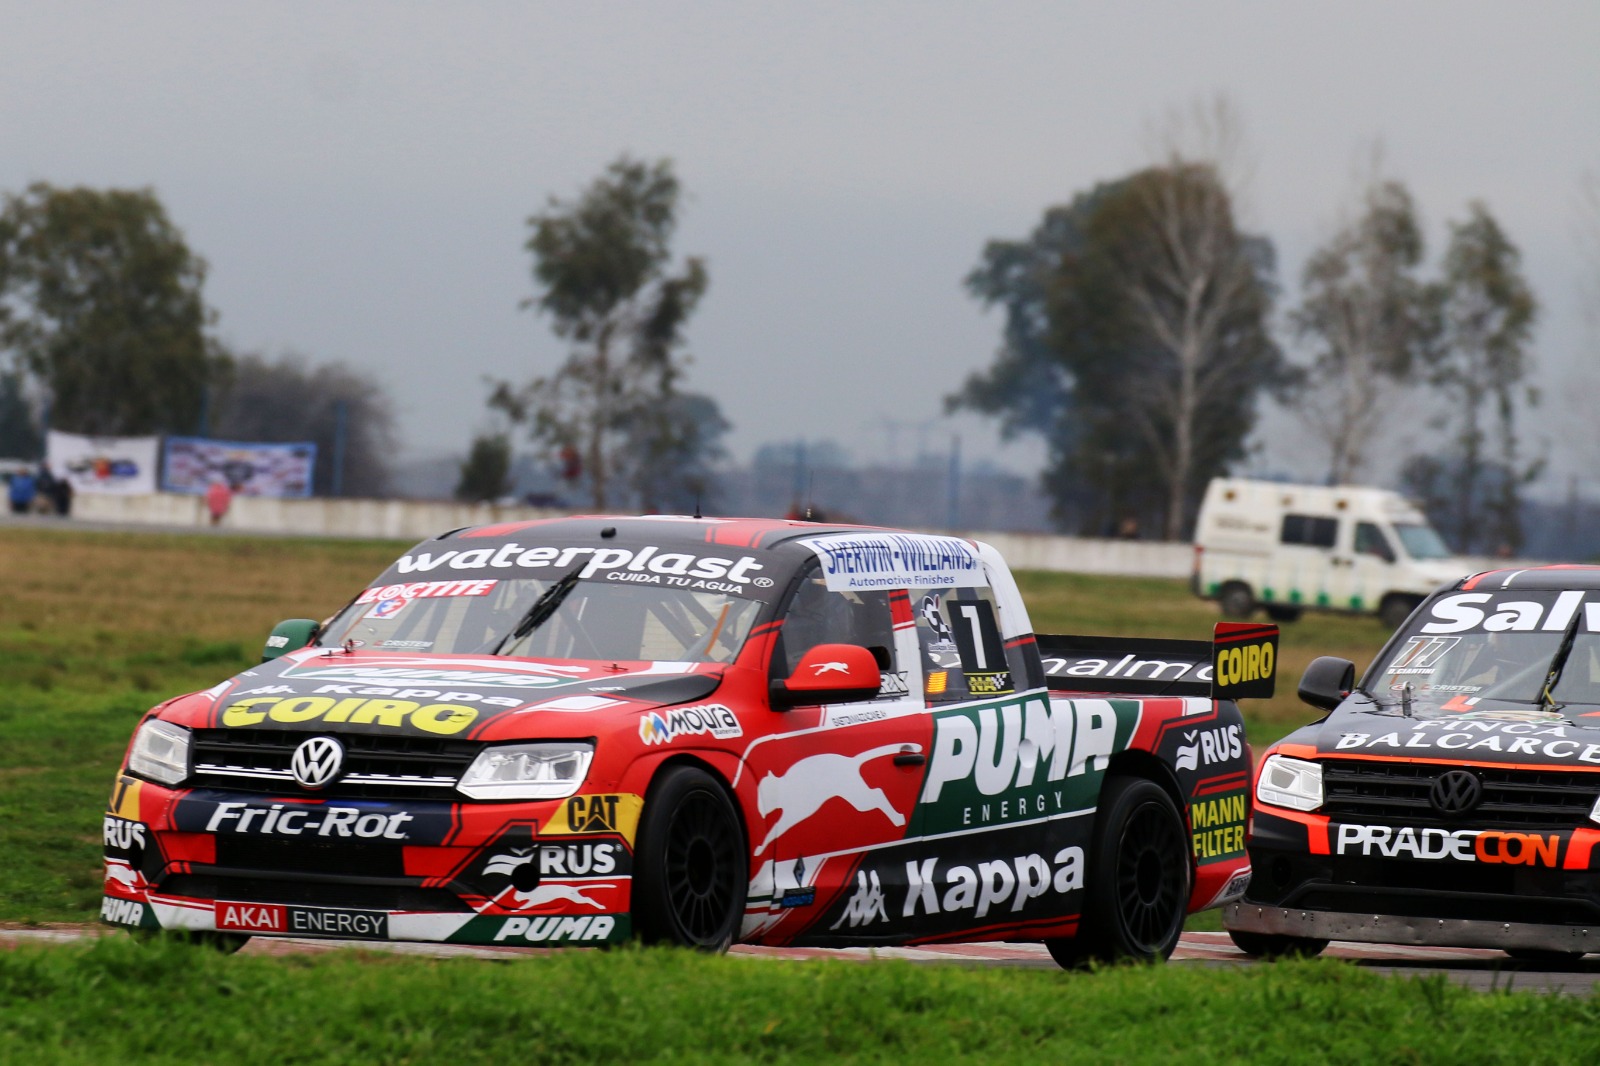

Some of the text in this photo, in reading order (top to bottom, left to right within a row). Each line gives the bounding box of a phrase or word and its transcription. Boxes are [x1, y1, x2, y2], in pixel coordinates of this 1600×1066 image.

[396, 543, 764, 584] waterplast
[812, 535, 973, 574] SHERWIN-WILLIAMS
[354, 579, 499, 605] LOCTITE
[606, 571, 743, 594] CUIDA TU AGUA
[850, 573, 955, 587] Automotive Finishes
[960, 606, 987, 669] 1
[1217, 641, 1274, 687] COIRO
[313, 684, 524, 707] Kappa
[1431, 684, 1483, 692] CRISTEM
[1200, 724, 1242, 765] RUS
[1412, 720, 1567, 737] FINCA
[920, 699, 1118, 803] PUMA
[206, 802, 414, 840] Fric-Rot
[567, 796, 620, 832] CAT
[963, 791, 1063, 825] ENERGY
[1192, 795, 1245, 829] MANN
[103, 817, 146, 850] RUS
[1192, 825, 1245, 858] FILTER
[539, 844, 616, 875] RUS
[902, 846, 1085, 918] Kappa
[100, 896, 144, 926] PUMA
[223, 906, 384, 934] AKAI ENERGY
[492, 916, 616, 942] PUMA
